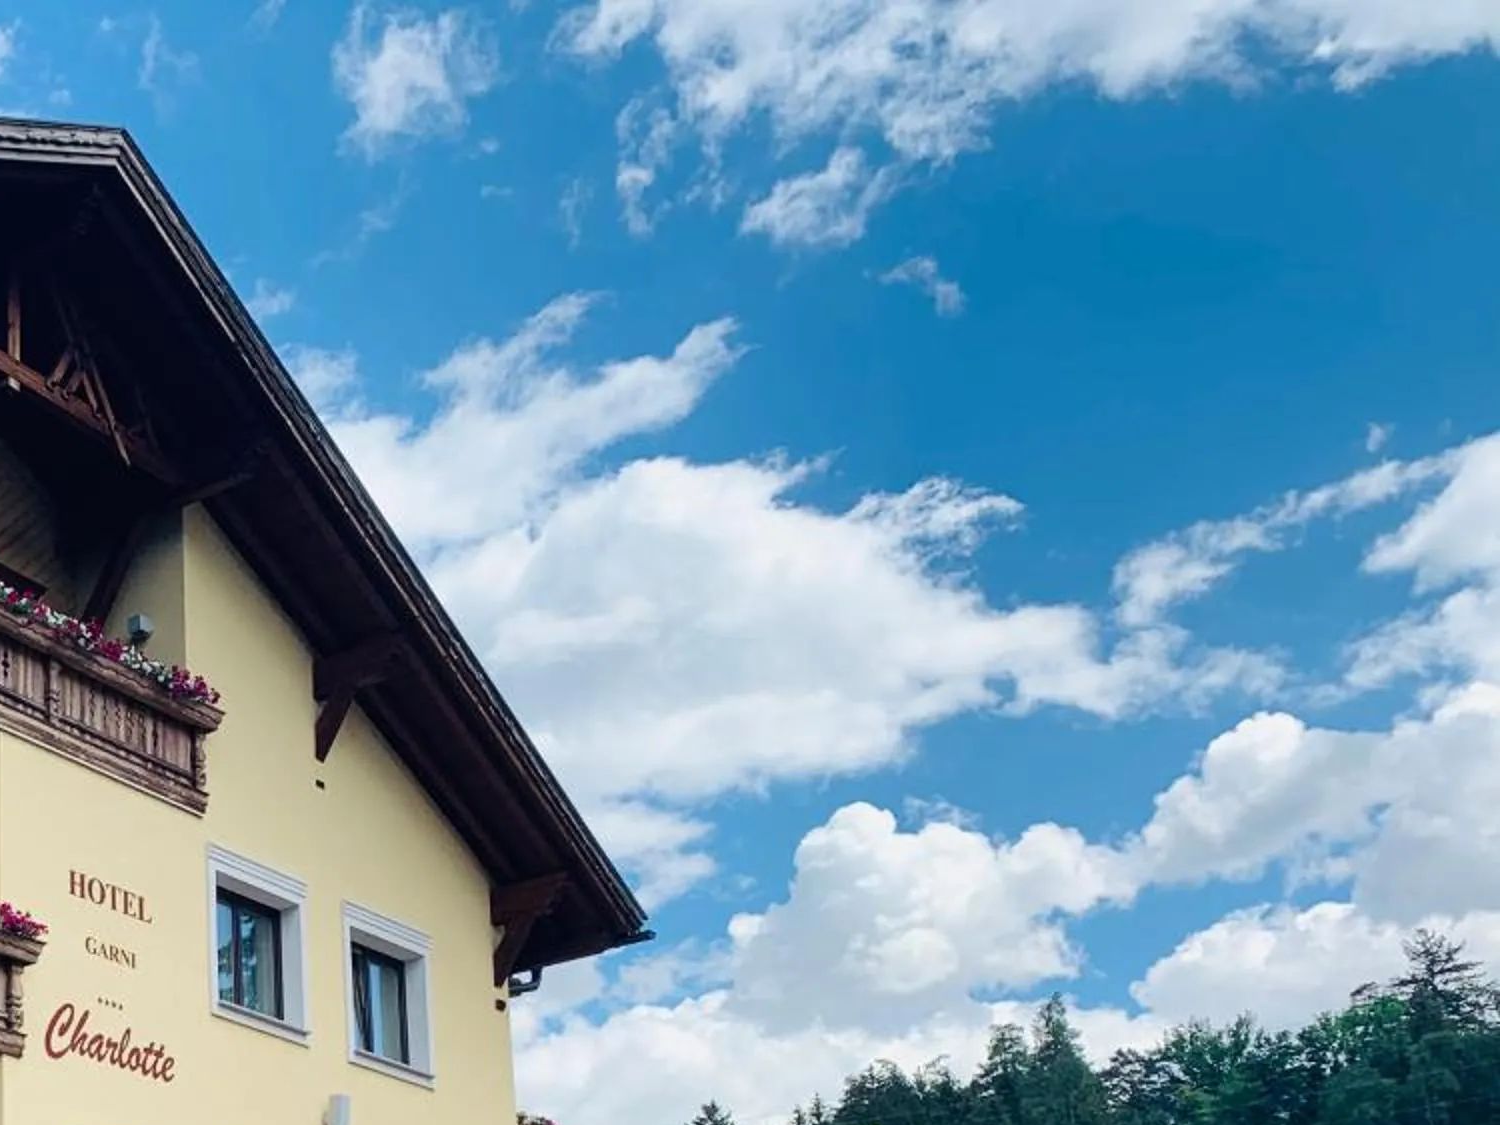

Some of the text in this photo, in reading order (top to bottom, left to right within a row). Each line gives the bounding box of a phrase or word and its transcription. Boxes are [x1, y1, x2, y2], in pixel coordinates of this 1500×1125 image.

[68, 869, 153, 924] HOTEL
[85, 936, 136, 970] GARNI
[45, 1003, 176, 1083] Charlotte
